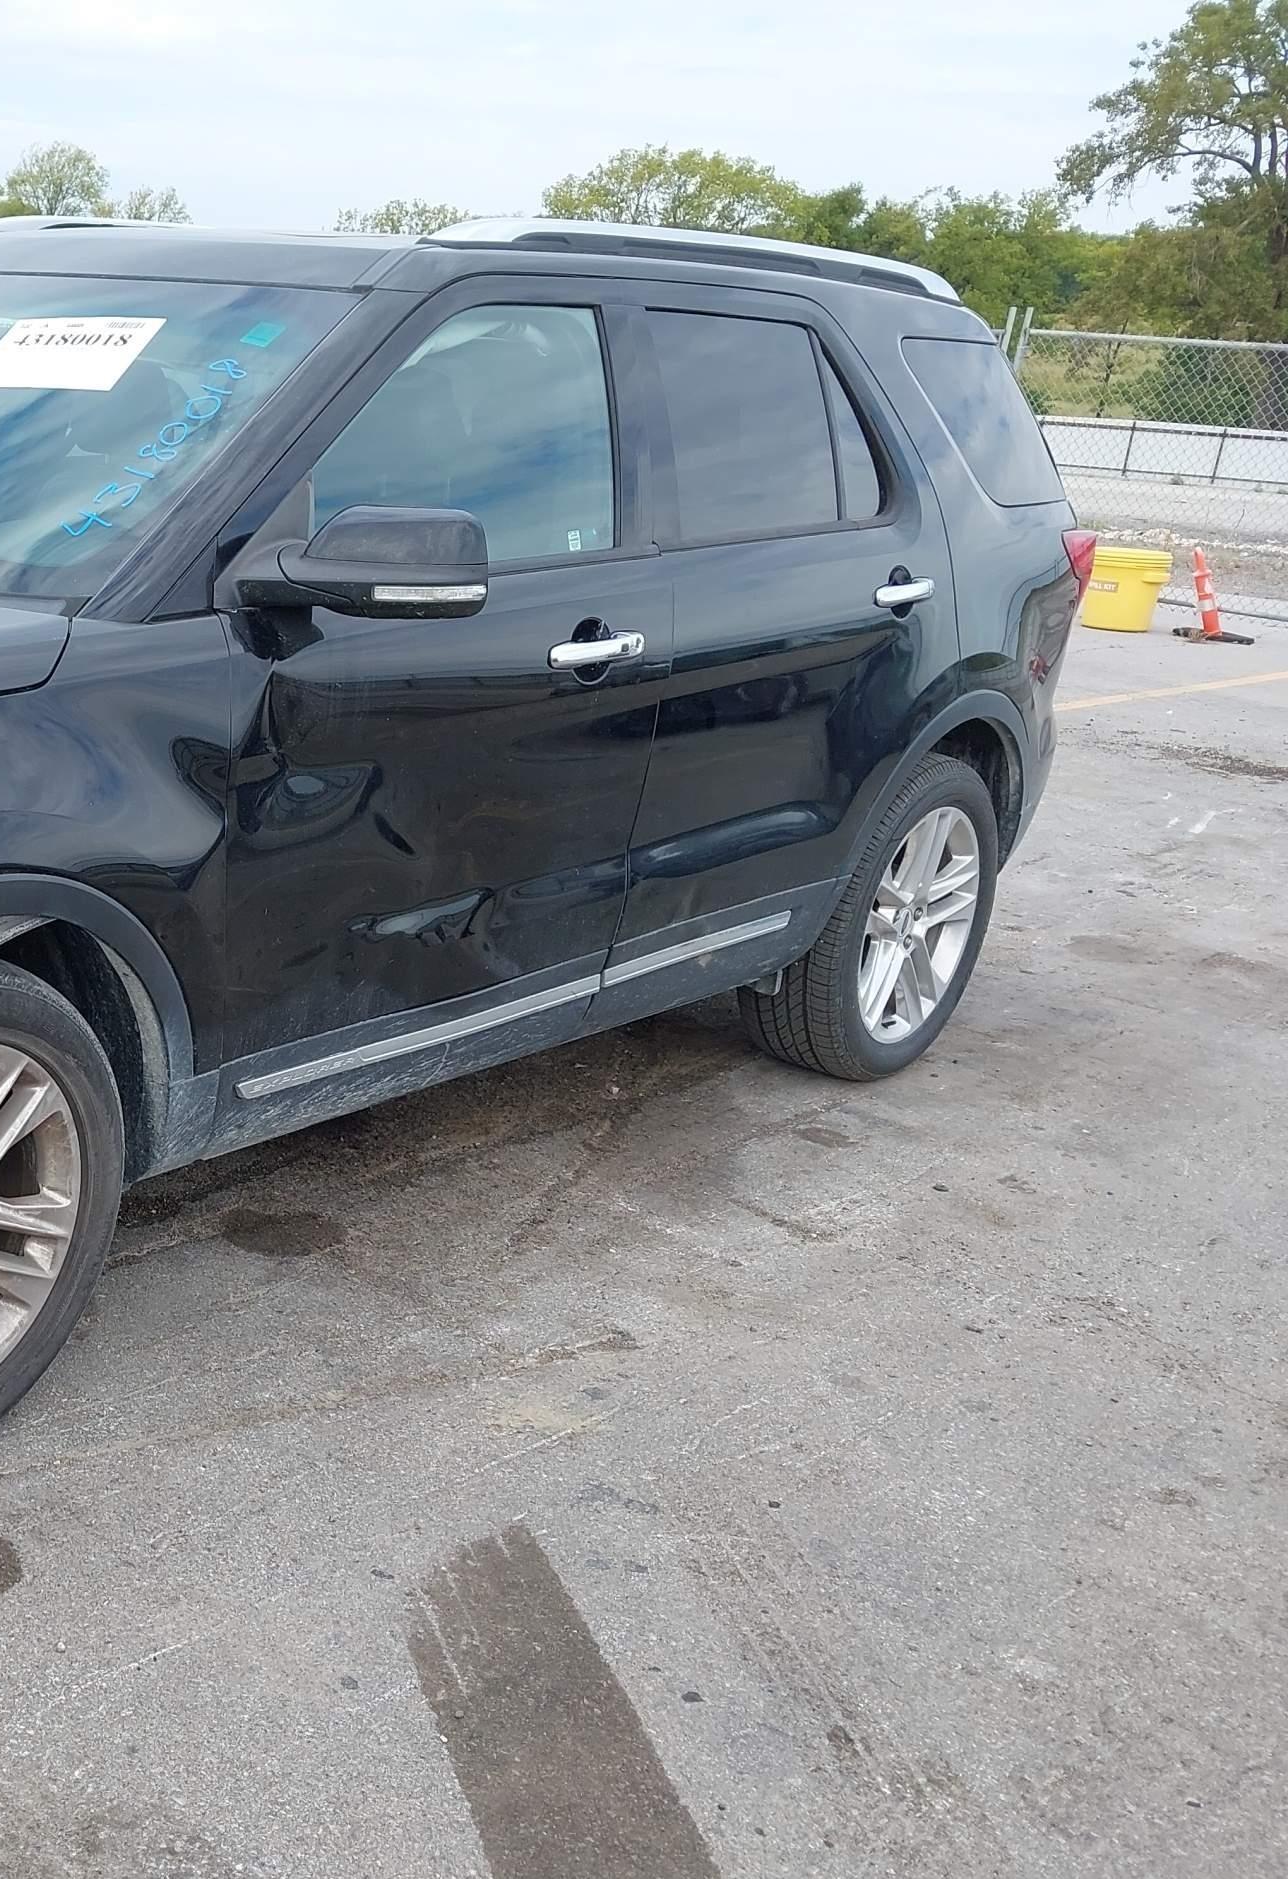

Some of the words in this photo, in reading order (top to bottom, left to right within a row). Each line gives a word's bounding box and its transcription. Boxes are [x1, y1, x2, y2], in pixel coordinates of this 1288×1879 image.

[12, 333, 133, 347] 43180018
[59, 358, 248, 537] 43180018
[248, 1057, 354, 1094] EXPLORER
